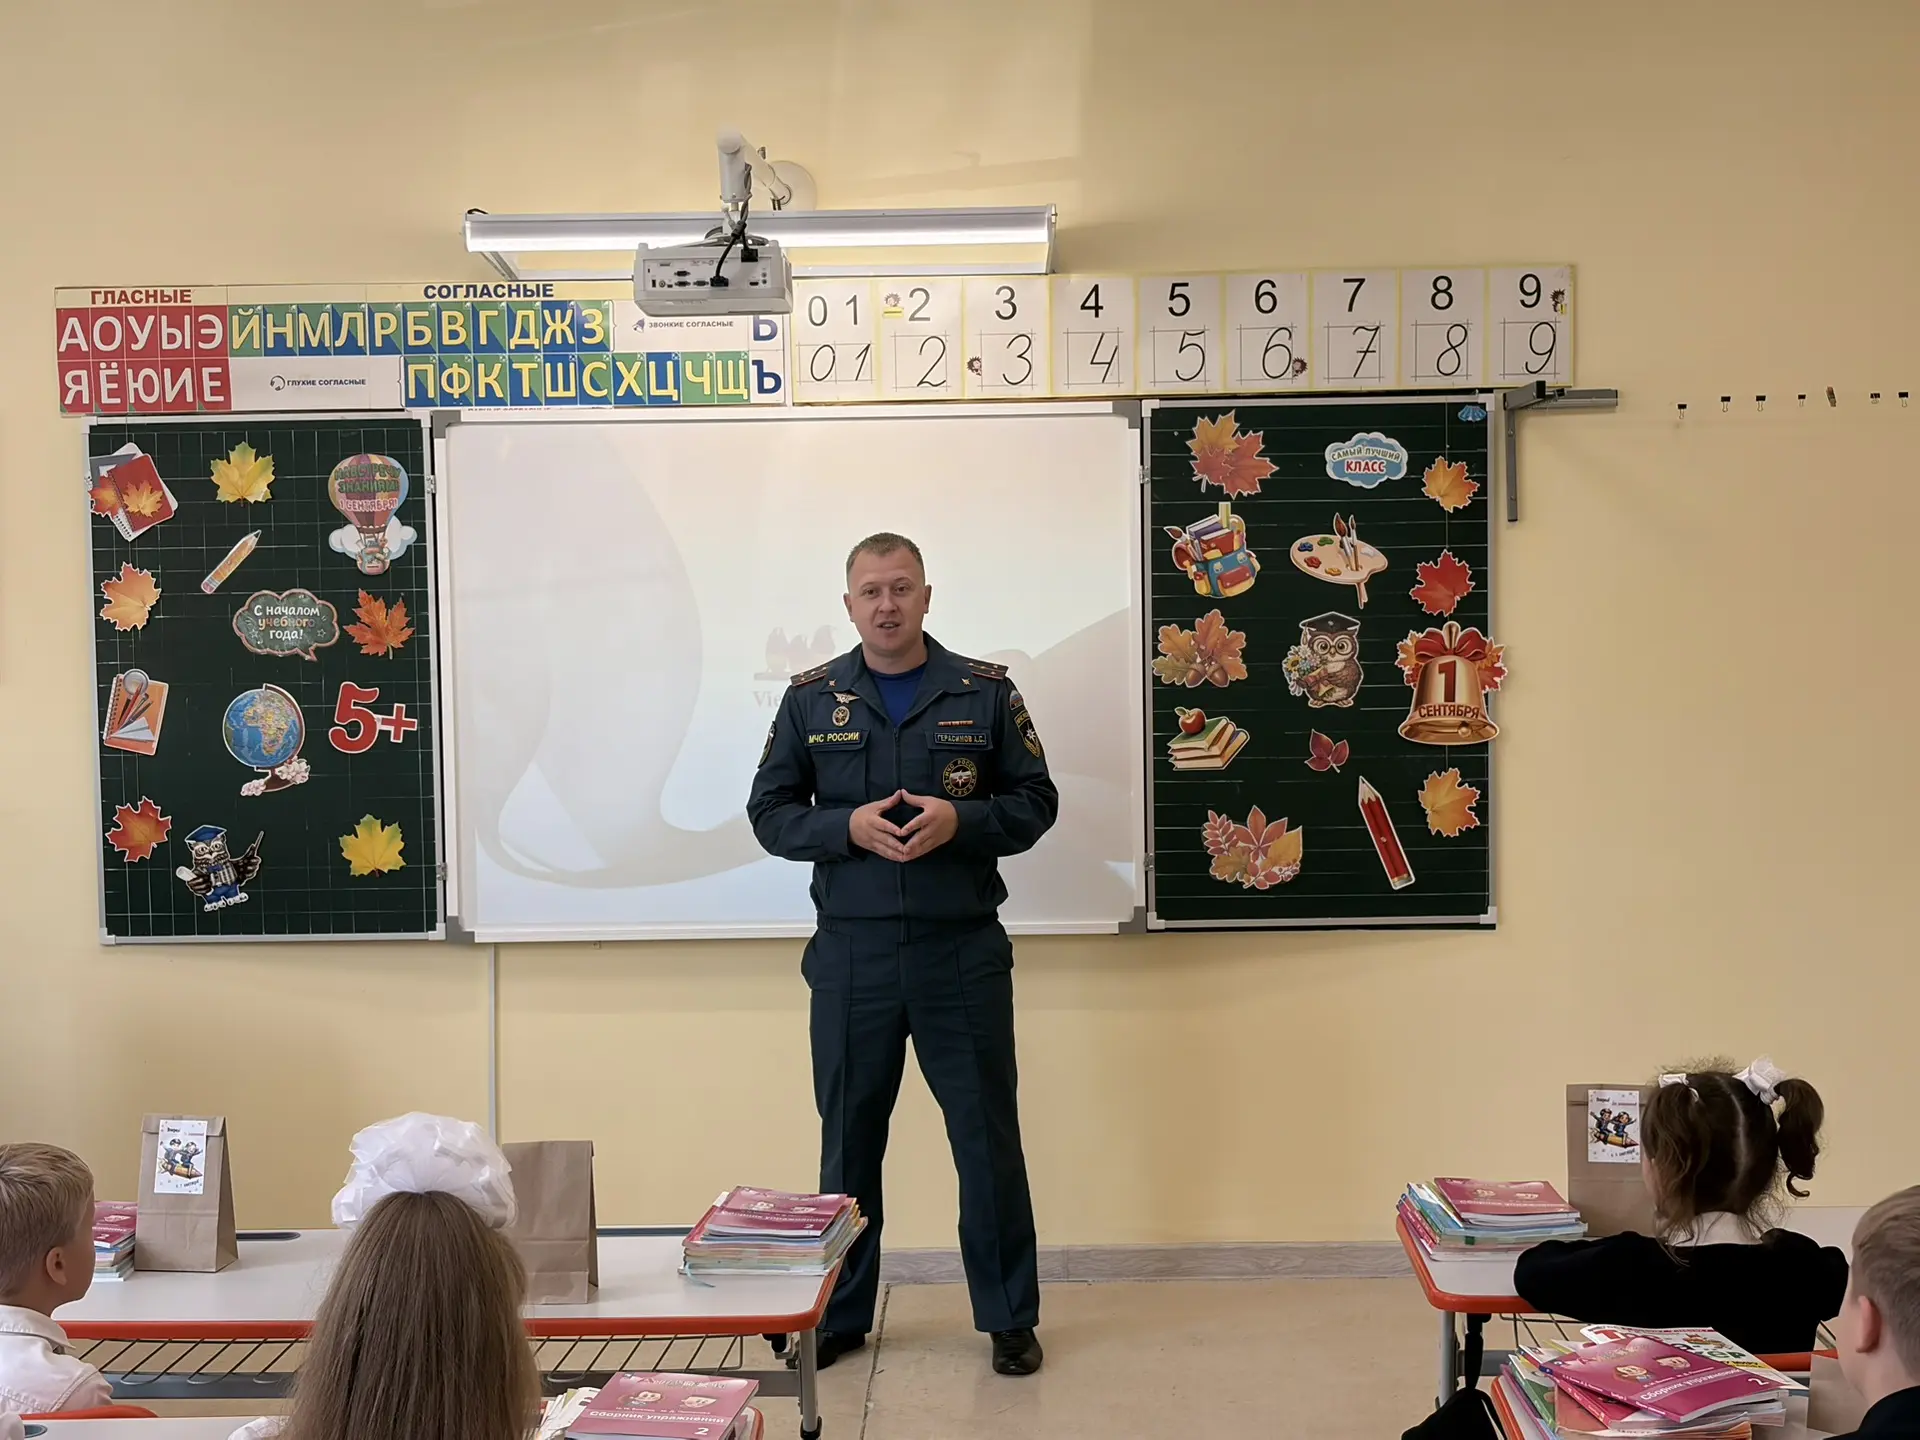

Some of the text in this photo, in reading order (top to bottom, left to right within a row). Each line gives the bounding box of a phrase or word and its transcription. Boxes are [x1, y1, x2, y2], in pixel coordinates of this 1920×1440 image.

[91, 289, 192, 305] ГЛАСНЫЕ
[423, 283, 554, 300] СОГЛАСНЫЕ
[808, 273, 1542, 327] 0 1 2 3 4 5 6 7 8 9
[648, 320, 734, 329] ЗВОНКИЕ СОГЛАСНЫЕ
[810, 321, 1556, 388] 0 1 2 3 4 5 6 7 8 9
[286, 378, 367, 387] ГЛУХИЕ СОГЛАСНЫЕ
[751, 359, 782, 395] Ъ
[1331, 445, 1401, 462] САМЫЙ ЛУЧШИЙ
[1345, 460, 1386, 473] КЛАСС
[254, 604, 320, 617] С началом
[258, 615, 315, 631] учебного
[269, 629, 304, 641] года!
[1438, 659, 1457, 703] 1
[329, 681, 418, 754] 5+
[1418, 704, 1480, 719] СЕНТЯБРЯ
[808, 731, 860, 744] МЧС РОССИИ
[937, 734, 972, 743] ГЕРАСИМОВ
[1747, 1377, 1770, 1386] 2
[589, 1410, 644, 1421] Сборник
[693, 1426, 710, 1436] 2
